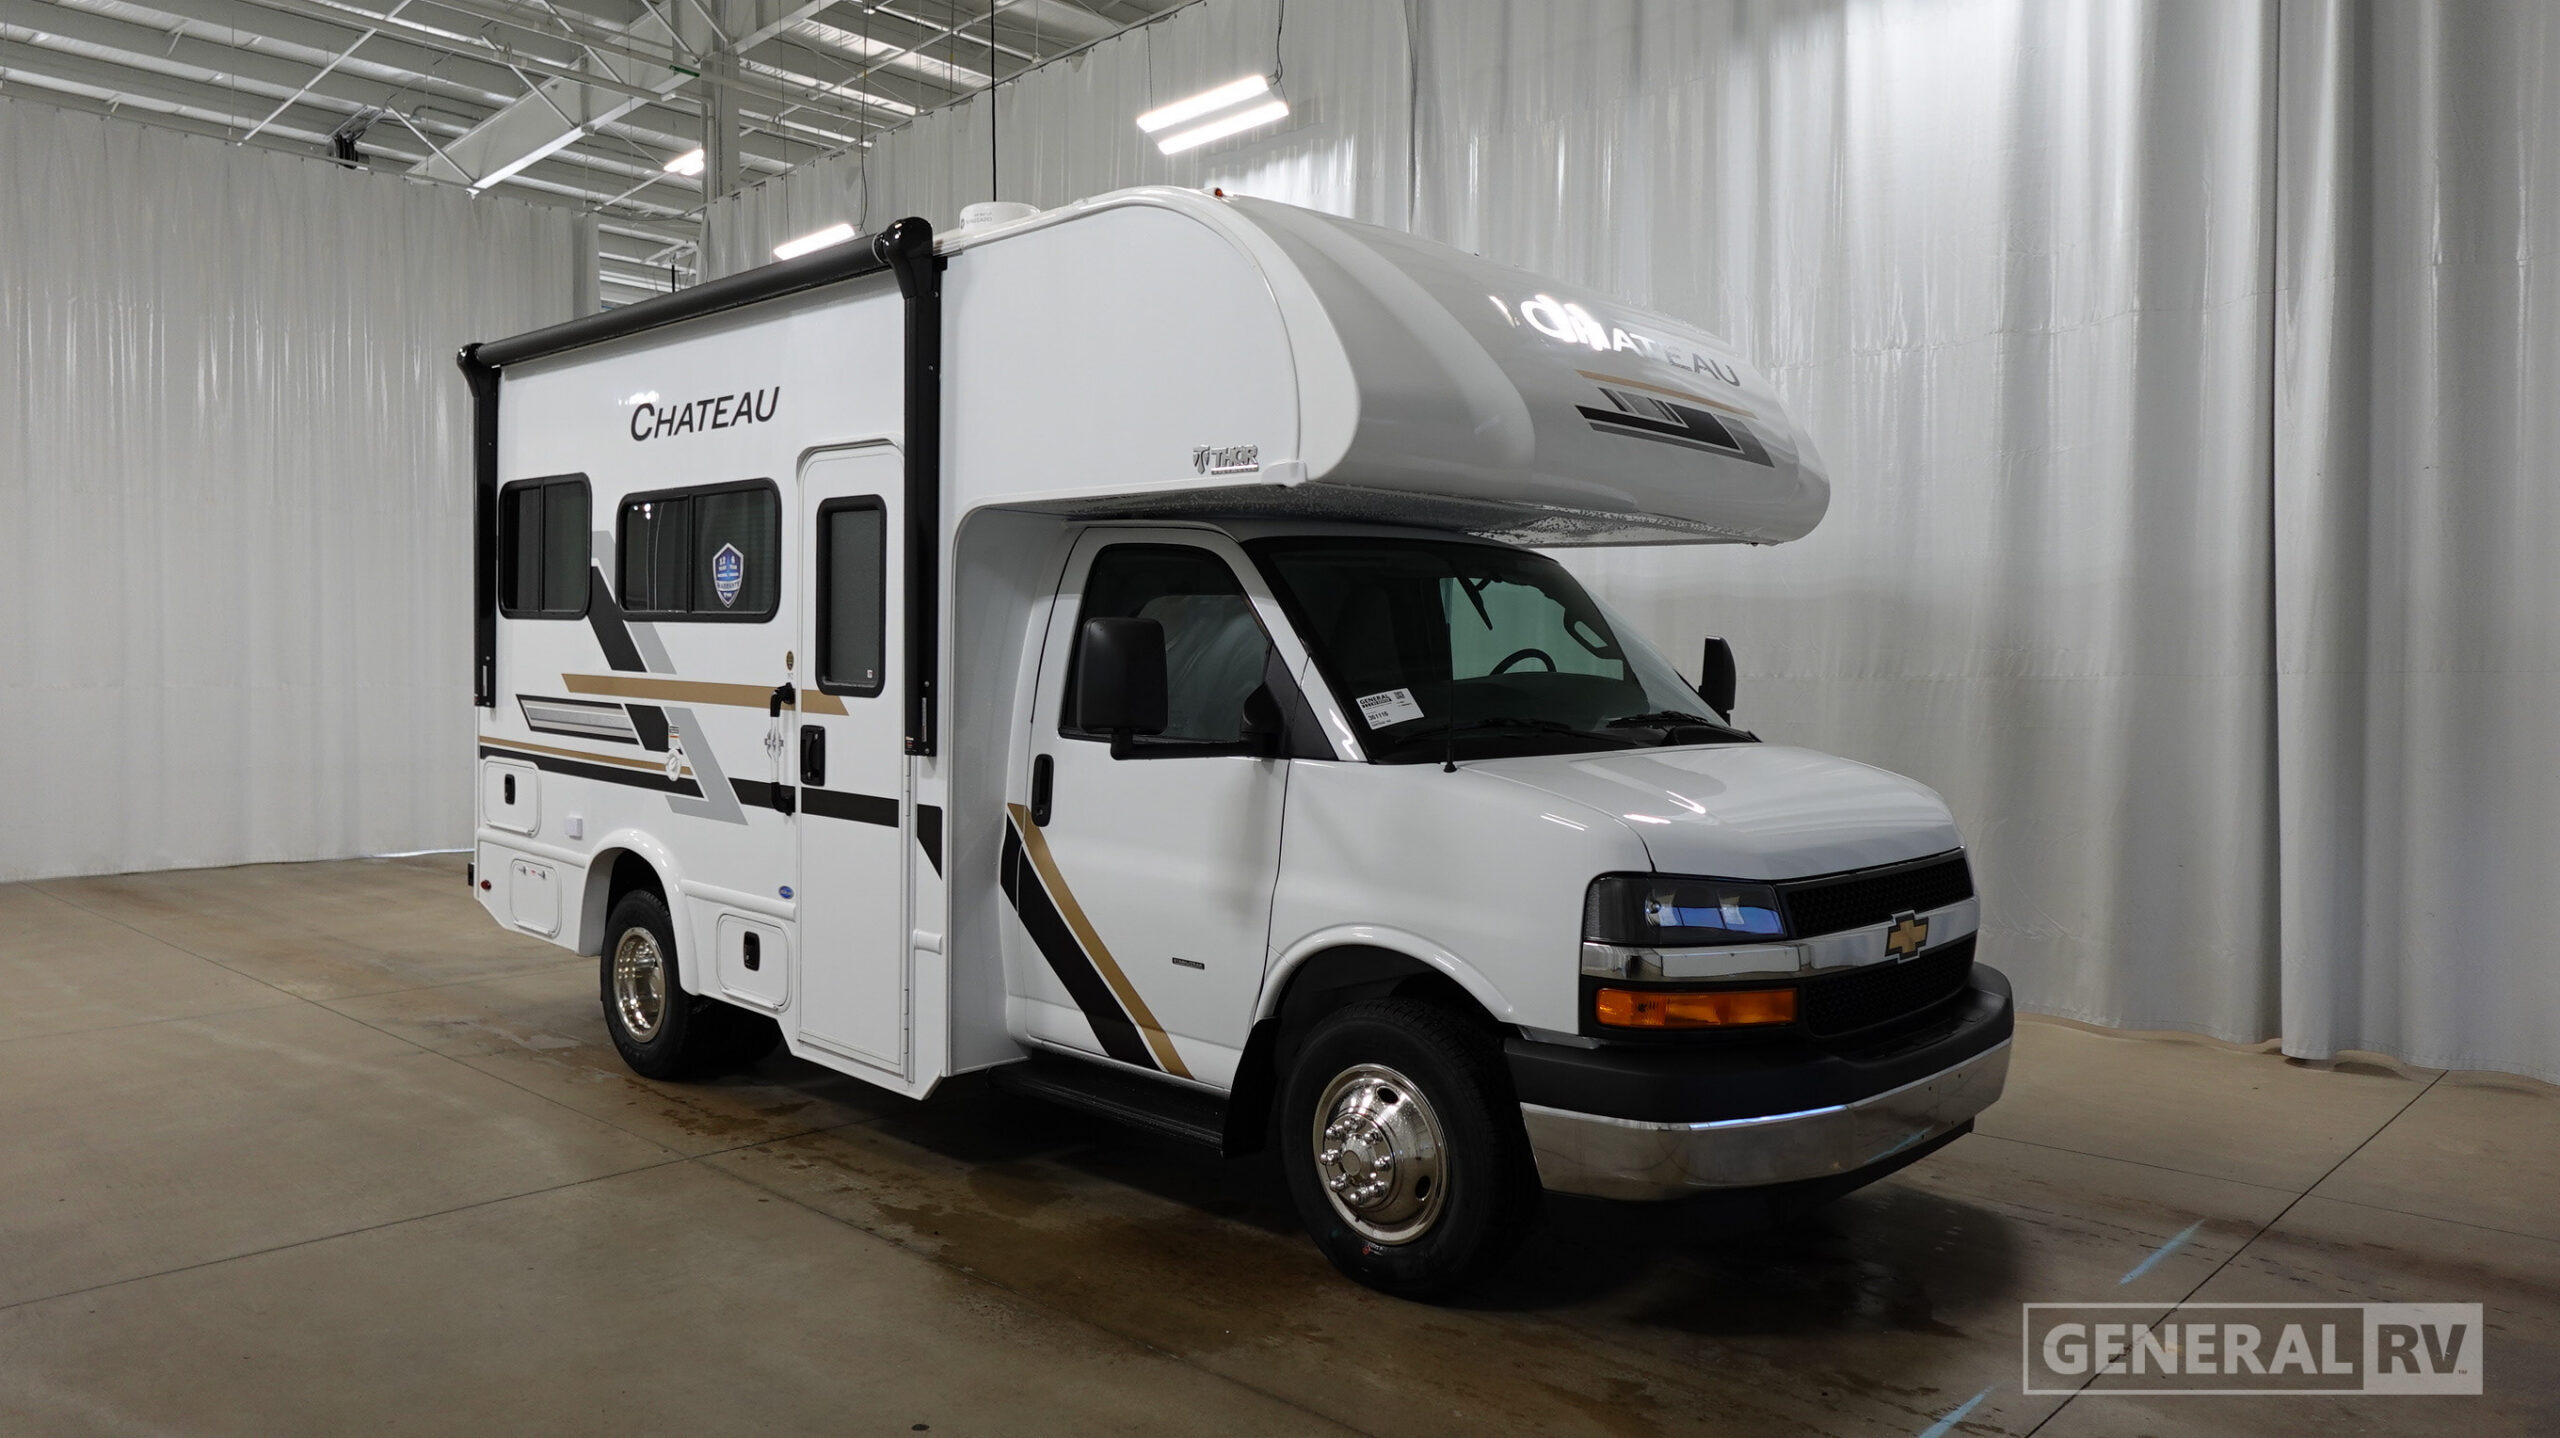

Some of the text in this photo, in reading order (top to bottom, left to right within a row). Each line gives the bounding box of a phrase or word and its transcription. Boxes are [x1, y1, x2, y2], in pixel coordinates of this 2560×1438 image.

[630, 386, 780, 441] CHATEAU
[1211, 445, 1258, 467] THOR
[1360, 694, 1390, 704] GENERAL
